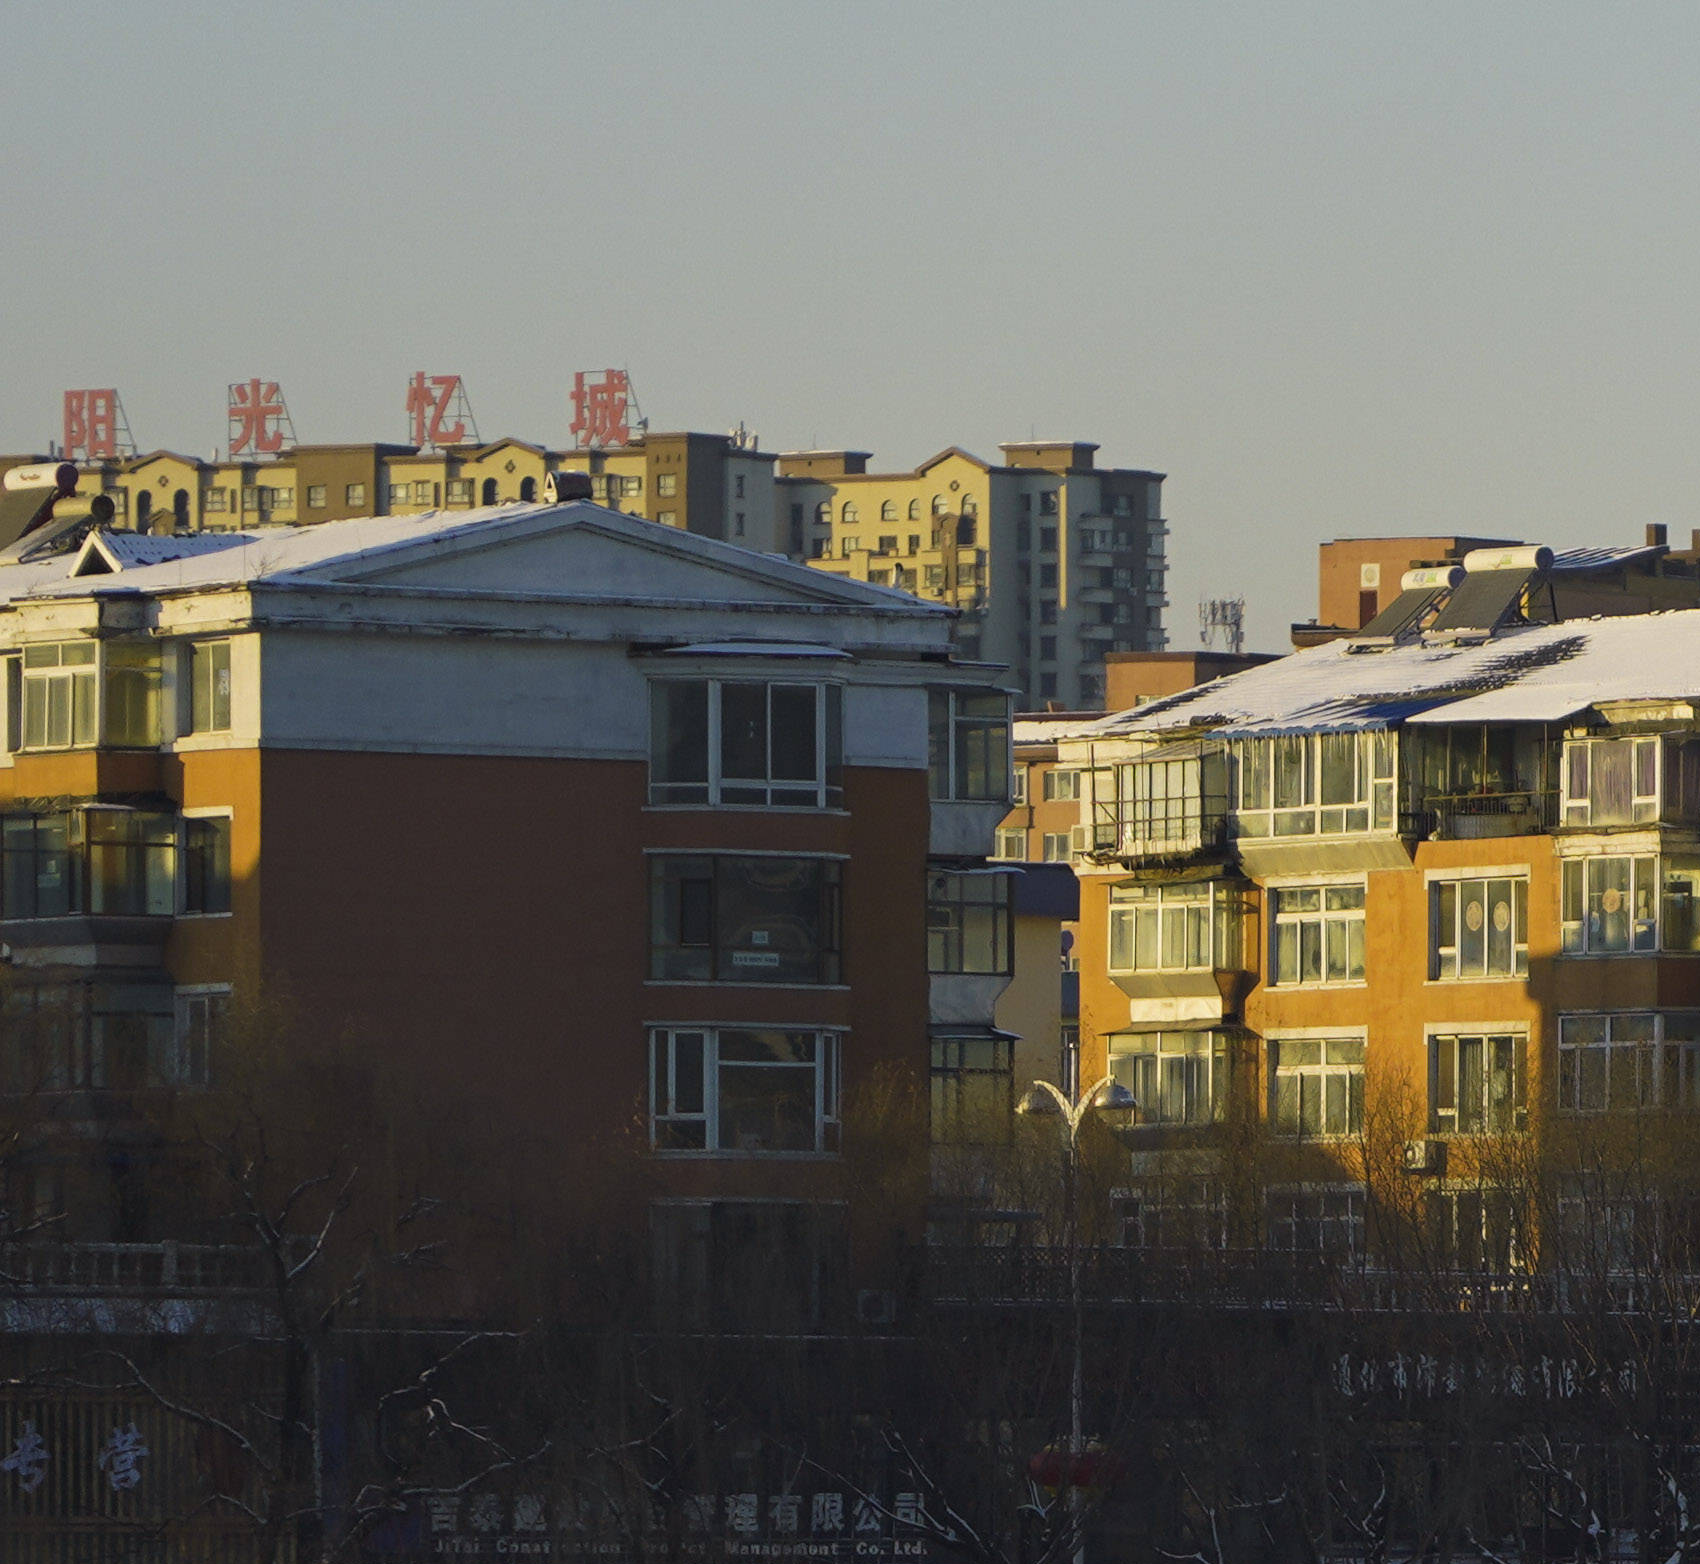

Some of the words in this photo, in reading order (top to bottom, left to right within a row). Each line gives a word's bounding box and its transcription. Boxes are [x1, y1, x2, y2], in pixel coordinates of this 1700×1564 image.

[63, 368, 629, 460] 阳光忆城
[426, 1492, 927, 1533] 吉泰建管理有限公司
